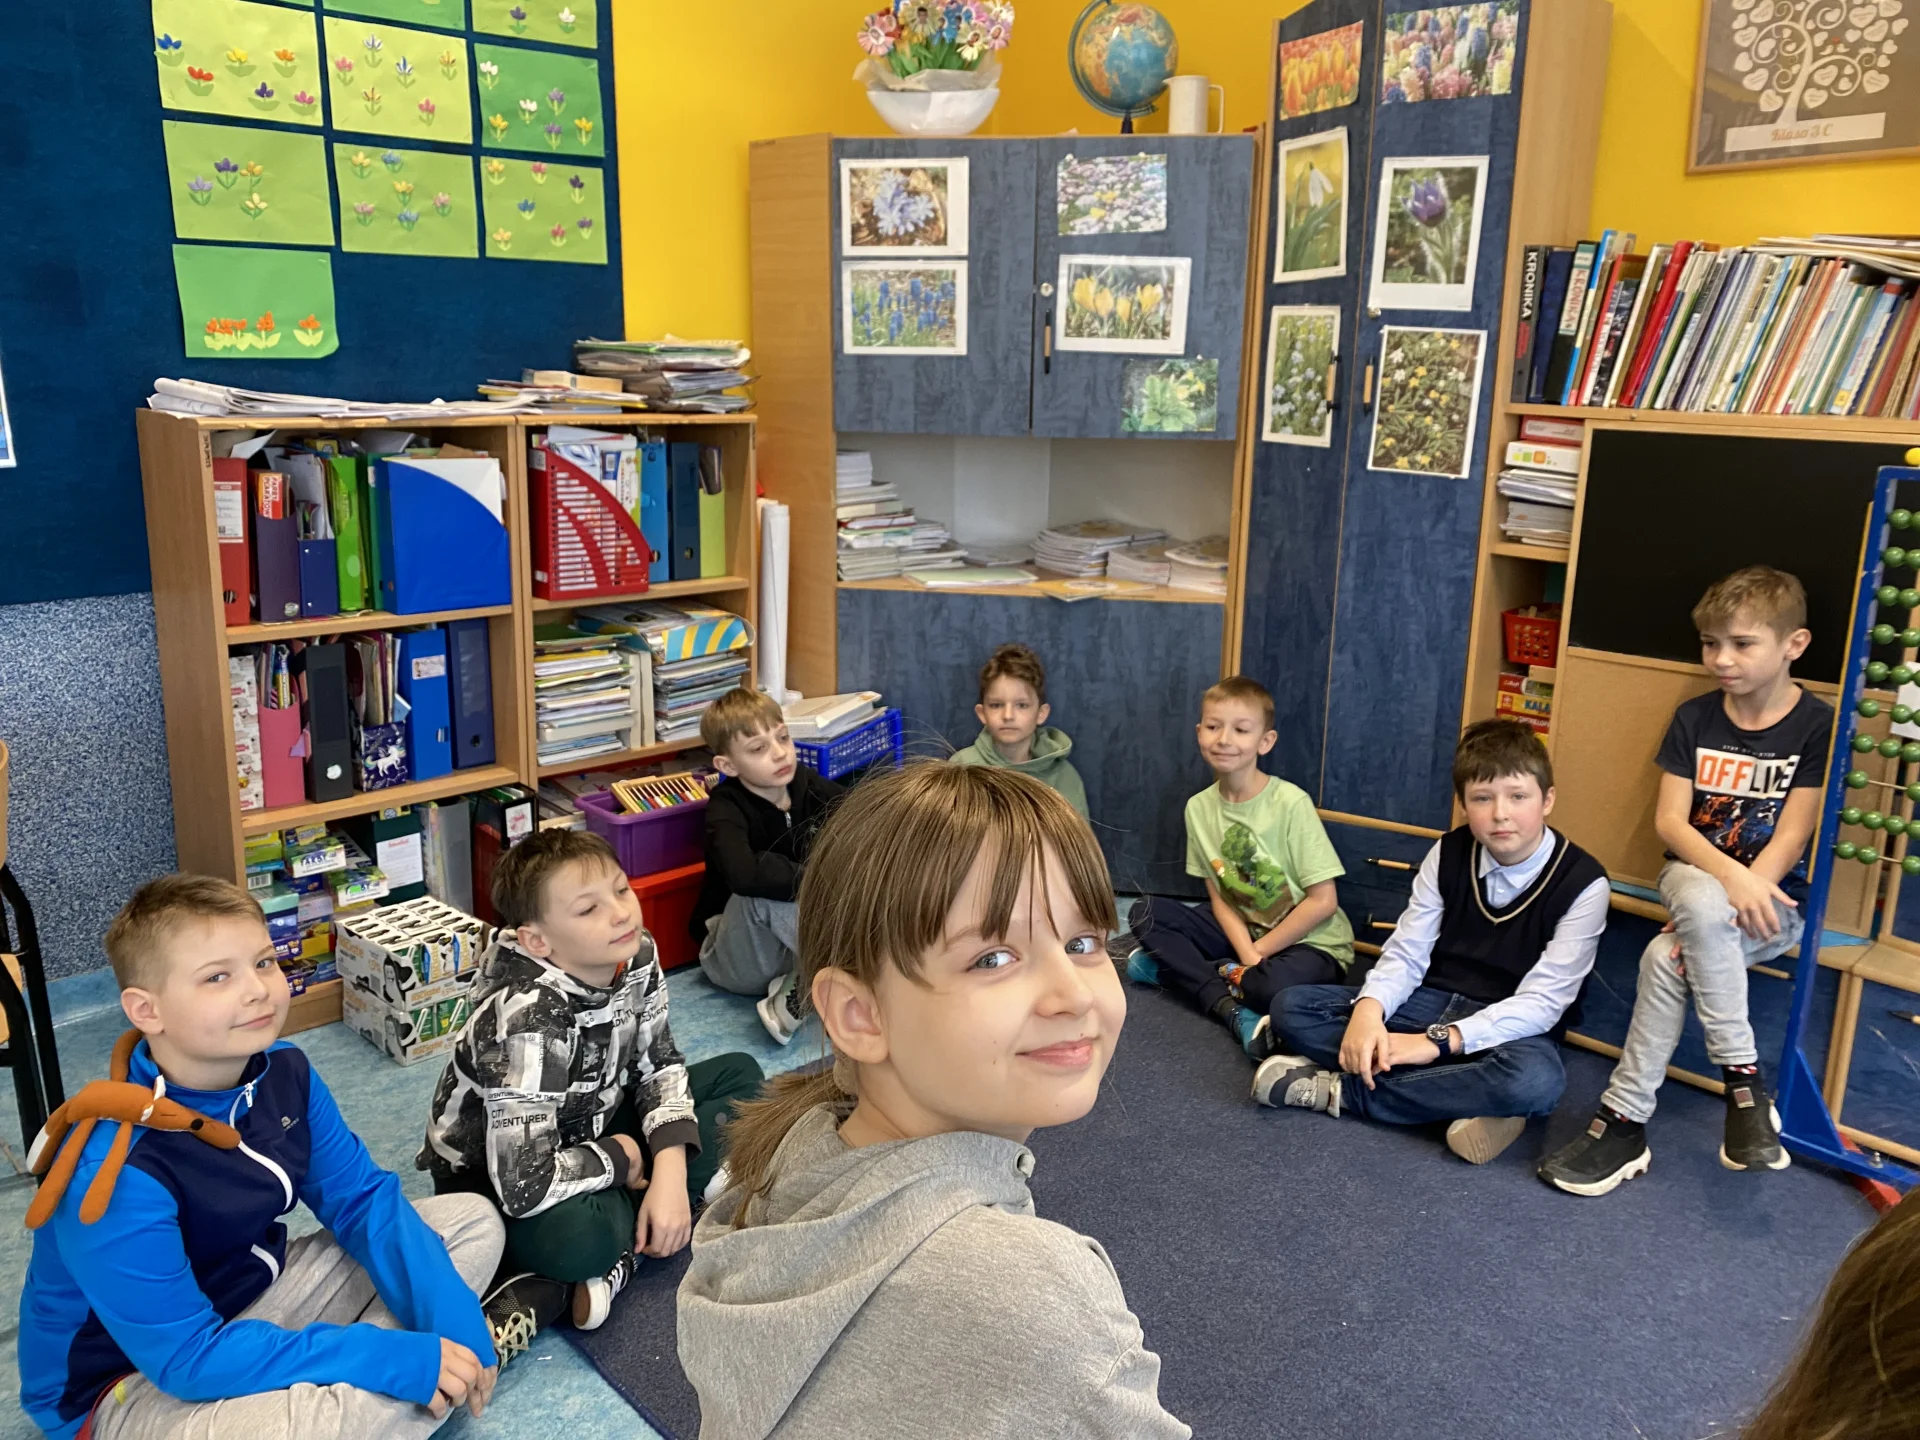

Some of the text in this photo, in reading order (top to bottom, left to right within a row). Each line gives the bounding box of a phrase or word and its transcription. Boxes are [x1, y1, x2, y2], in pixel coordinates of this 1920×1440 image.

[1521, 251, 1538, 318] KRONIKA
[1564, 269, 1588, 322] KRONIKA
[491, 1108, 505, 1119] CITY
[491, 1113, 548, 1130] ADVENTURER
